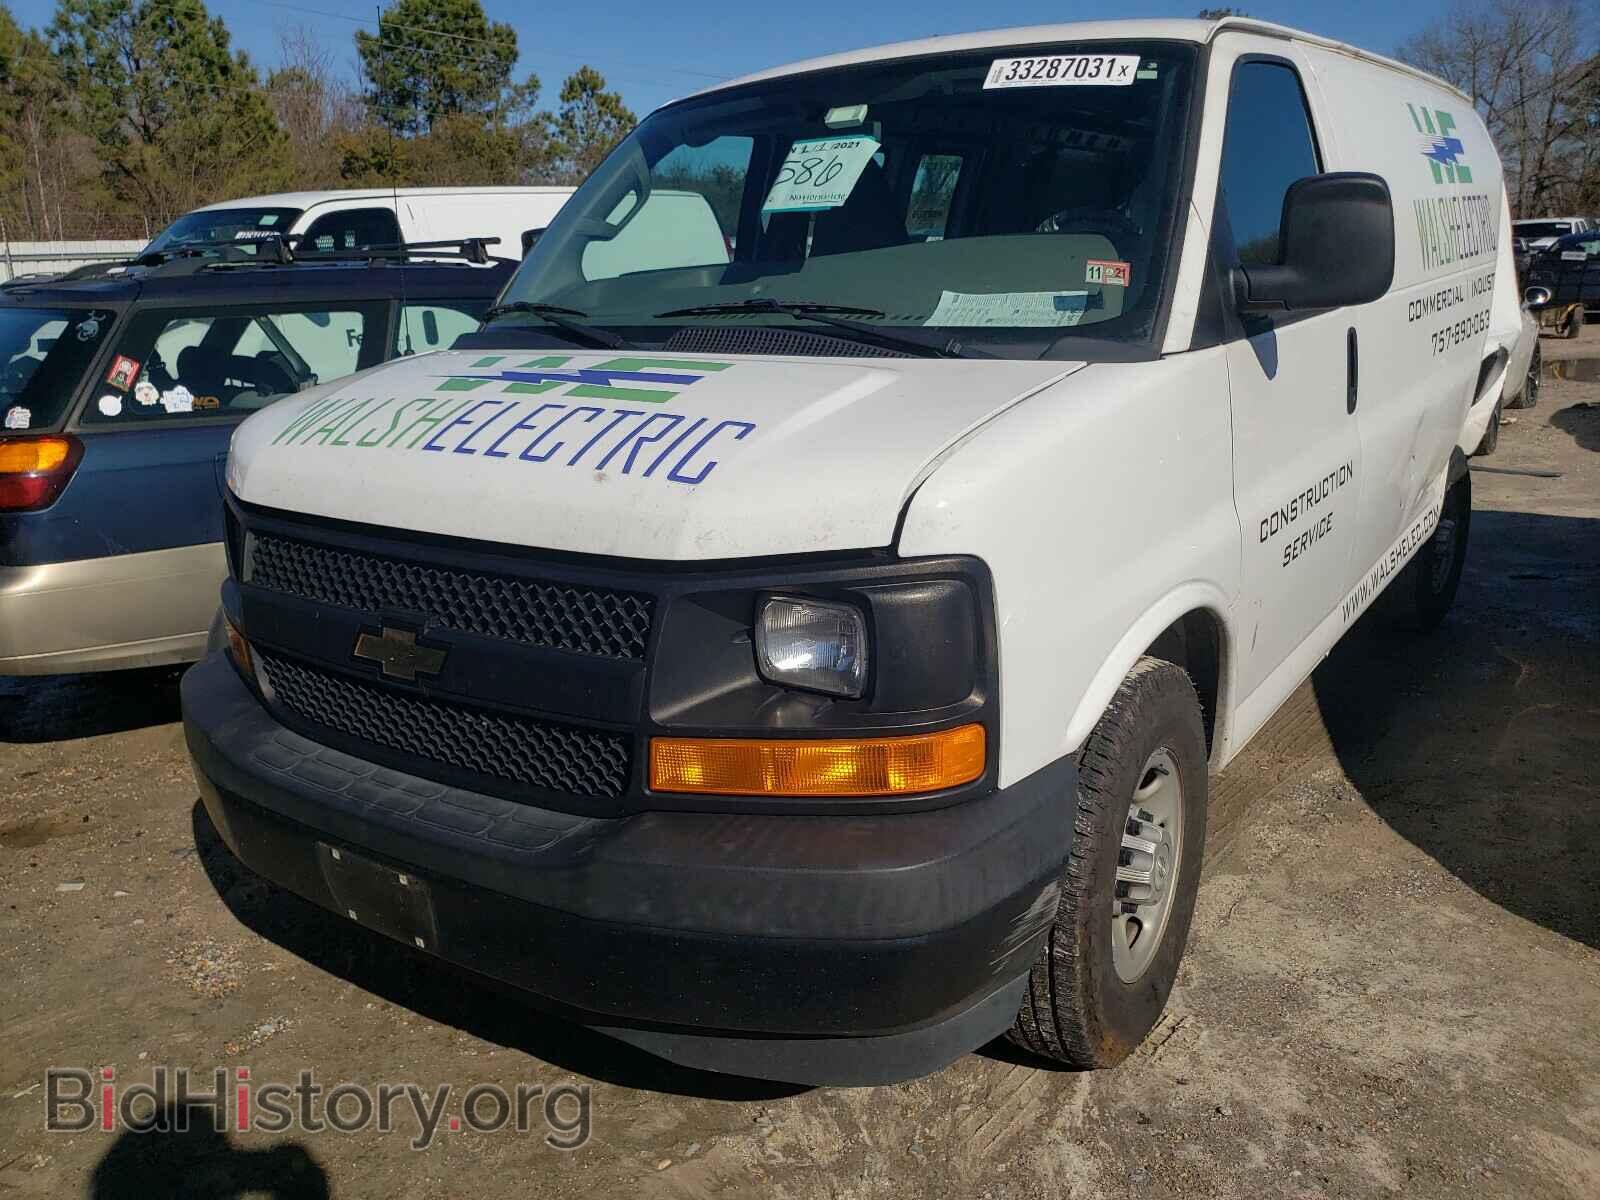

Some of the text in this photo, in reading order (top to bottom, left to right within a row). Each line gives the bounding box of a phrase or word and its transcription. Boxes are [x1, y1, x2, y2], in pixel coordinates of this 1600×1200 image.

[1005, 57, 1116, 81] 33287031
[1088, 266, 1126, 280] 11 21
[1408, 285, 1464, 323] COMMERCIAL
[271, 397, 757, 486] WALSHELECTRIC
[1259, 459, 1354, 544] CONSTRUCTION
[1282, 511, 1334, 568] SERVICE
[1341, 503, 1441, 625] WWW.WALSHELEC.COM
